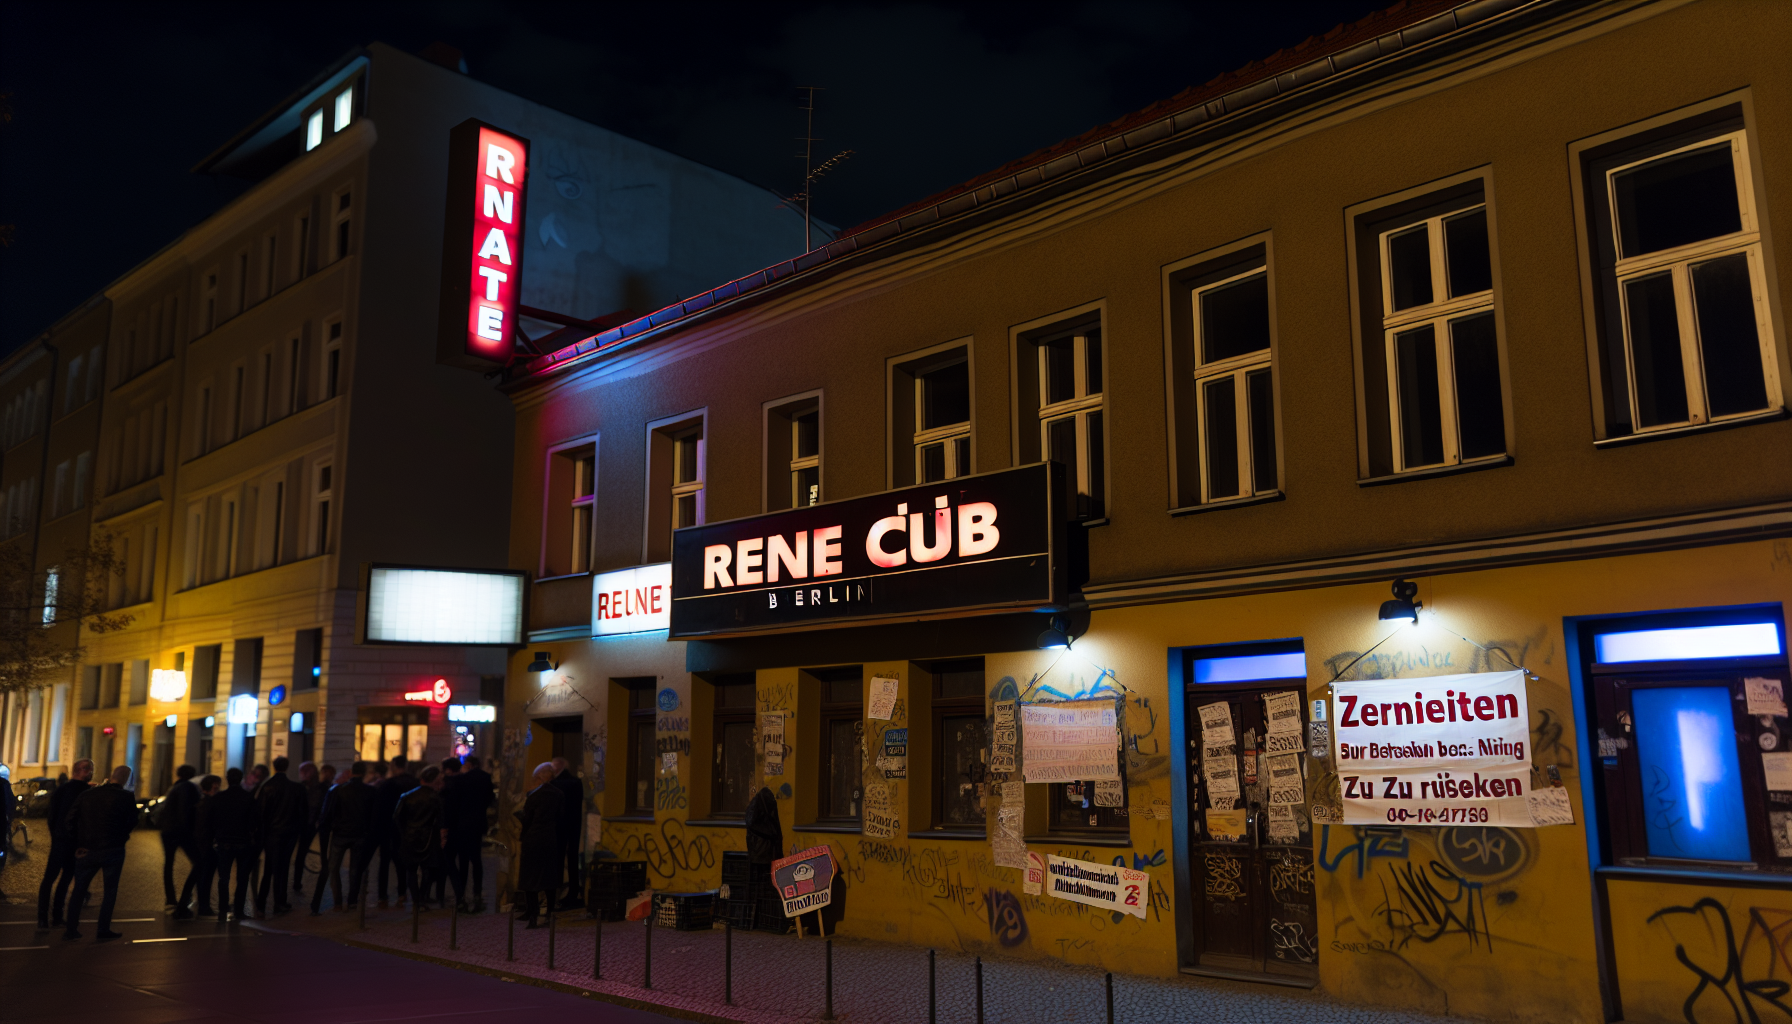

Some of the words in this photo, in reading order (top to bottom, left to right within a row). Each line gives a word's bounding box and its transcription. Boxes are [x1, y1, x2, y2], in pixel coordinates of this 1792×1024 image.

[478, 143, 515, 342] RNATE
[703, 524, 843, 590] RENE
[1339, 689, 1519, 728] Zernieiten
[1343, 776, 1374, 800] Zu
[1382, 776, 1413, 800] Zu
